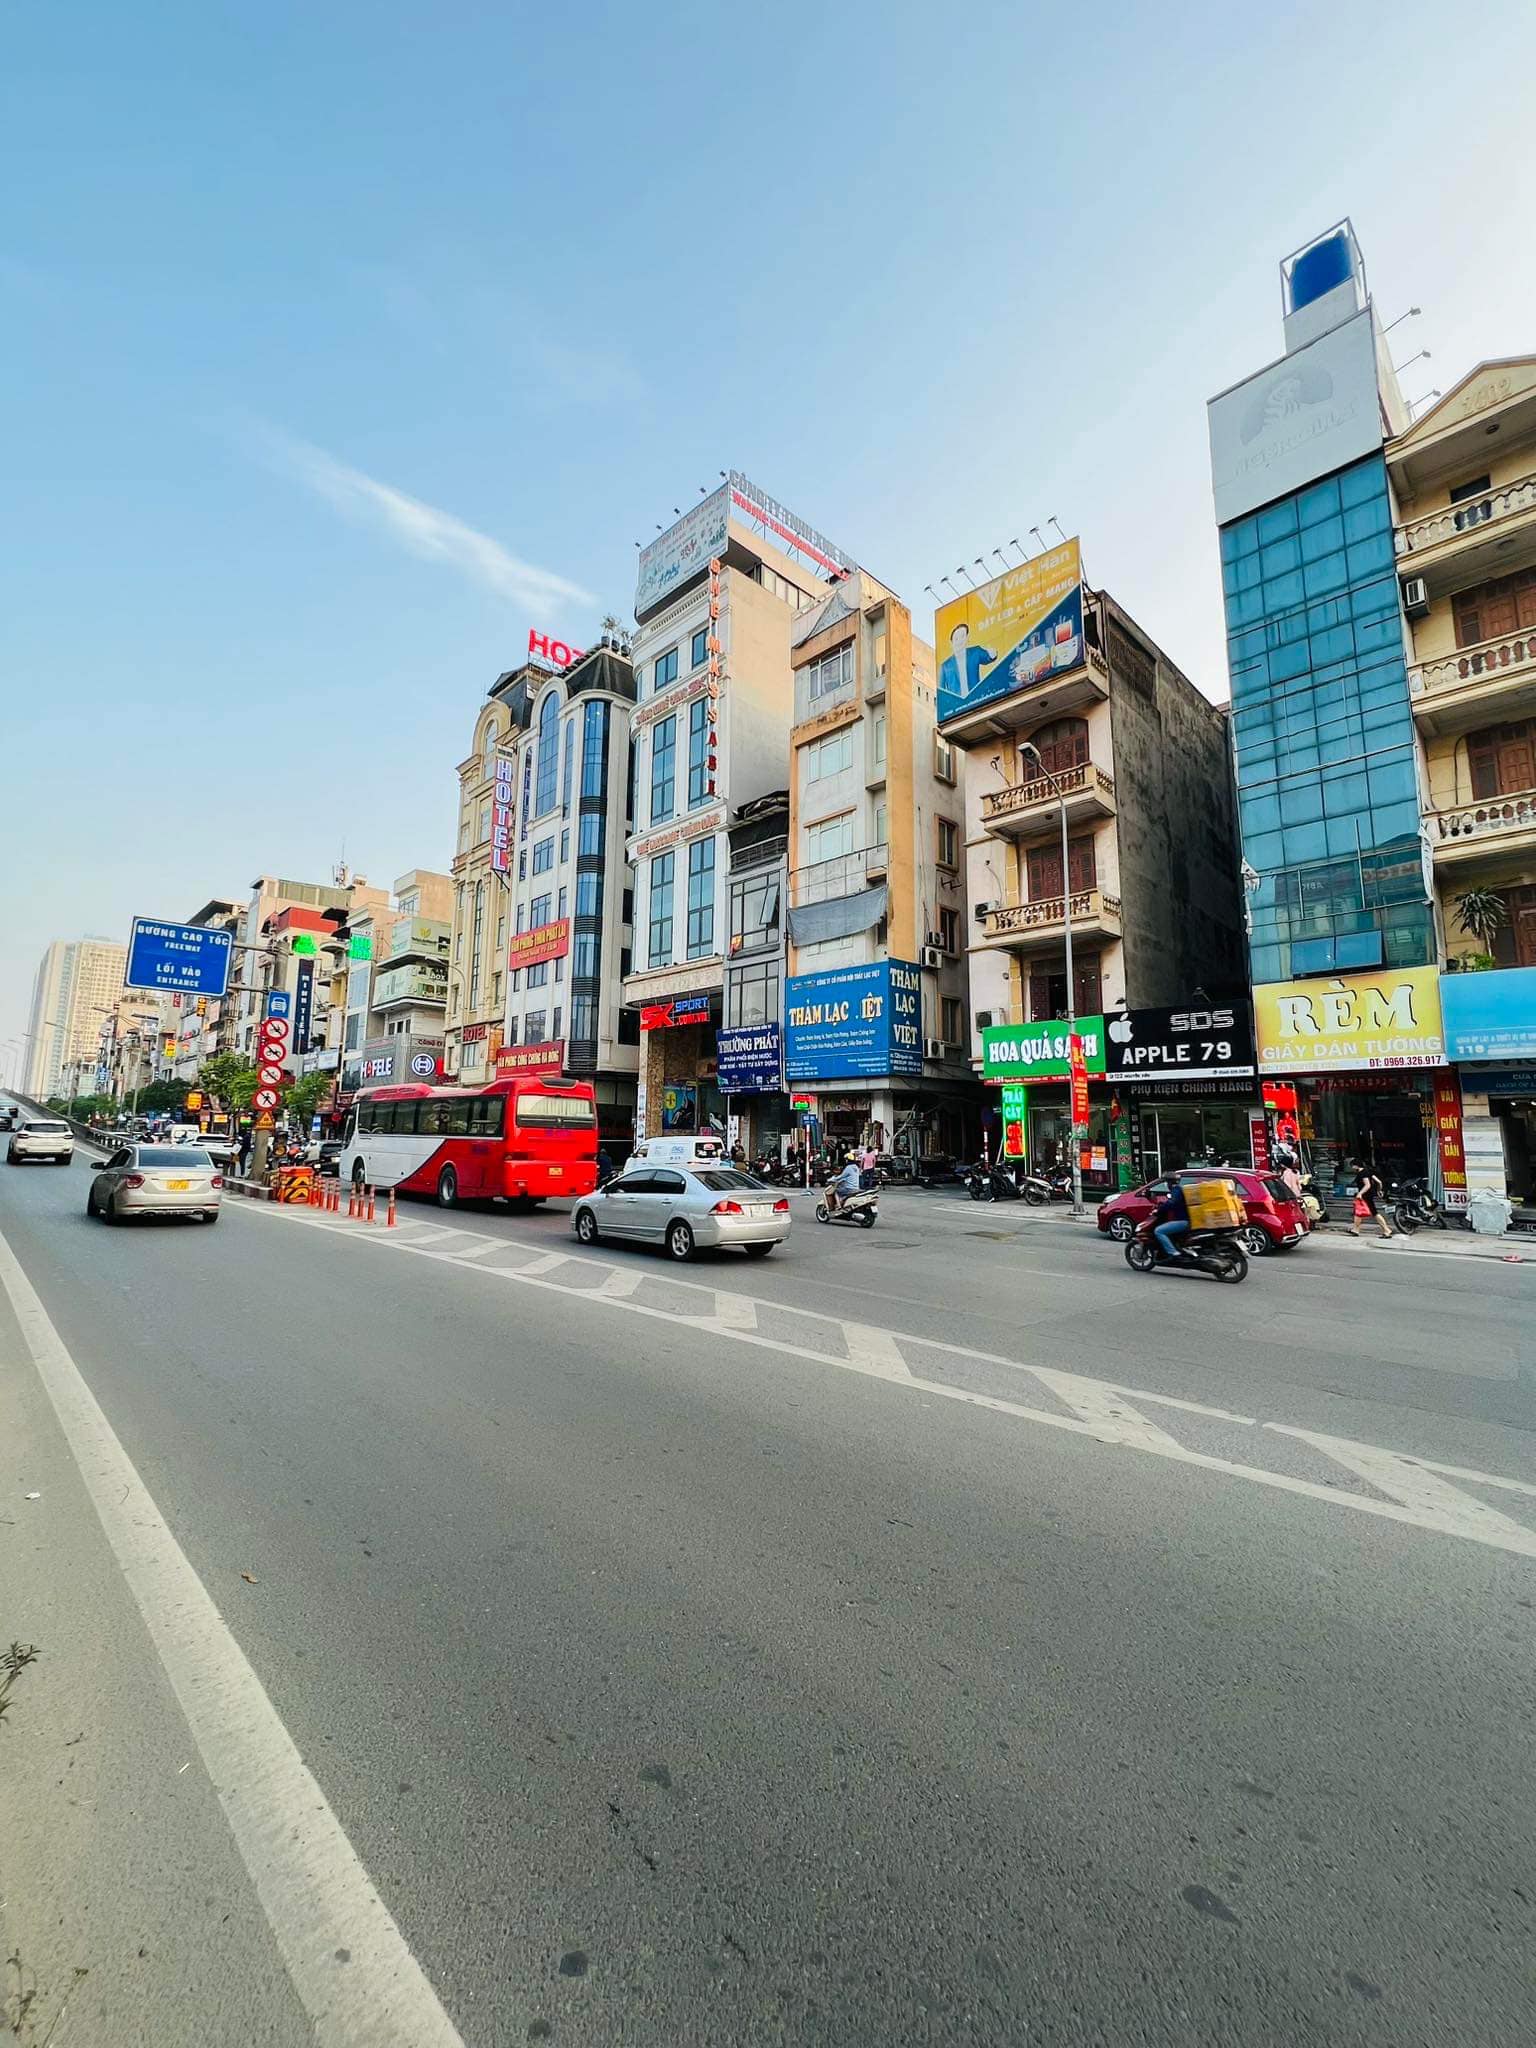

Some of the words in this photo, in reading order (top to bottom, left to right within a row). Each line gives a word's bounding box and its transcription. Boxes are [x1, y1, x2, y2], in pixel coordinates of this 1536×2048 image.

[491, 757, 513, 871] HOTEL
[165, 941, 201, 952] FREEWAY
[182, 932, 203, 942] CAO
[209, 934, 229, 946] TỐC
[156, 962, 175, 973] LỐI
[182, 966, 201, 977] VÀO
[890, 964, 919, 991] THẢM
[156, 976, 199, 987] ENTRANCE
[675, 997, 708, 1013] SPORT
[788, 999, 822, 1027] THẢM
[824, 1001, 849, 1026] LẠC
[895, 993, 915, 1017] LẠC
[1278, 979, 1418, 1037] RÈM
[640, 1002, 674, 1031] SK
[463, 1025, 487, 1042] HOTEL
[718, 1036, 752, 1053] TRƯỜNG
[754, 1032, 778, 1050] PHÁT
[893, 1020, 918, 1049] VIỆT
[989, 1041, 1019, 1063] HOA
[1020, 1030, 1053, 1065] QUẢ
[1122, 1044, 1191, 1065] APPLE
[1200, 1041, 1232, 1061] 79
[1263, 1039, 1307, 1060] GIẤY
[1314, 1040, 1357, 1057] DÁN
[1364, 1035, 1441, 1055] TƯỜNG
[1384, 1055, 1442, 1067] 0969.326.917
[1130, 1084, 1151, 1097] PHỤ
[1154, 1082, 1179, 1096] KIỆN
[1181, 1081, 1216, 1094] CHÍNH
[1440, 1113, 1458, 1129] GIẤY
[1447, 1192, 1467, 1204] 120
